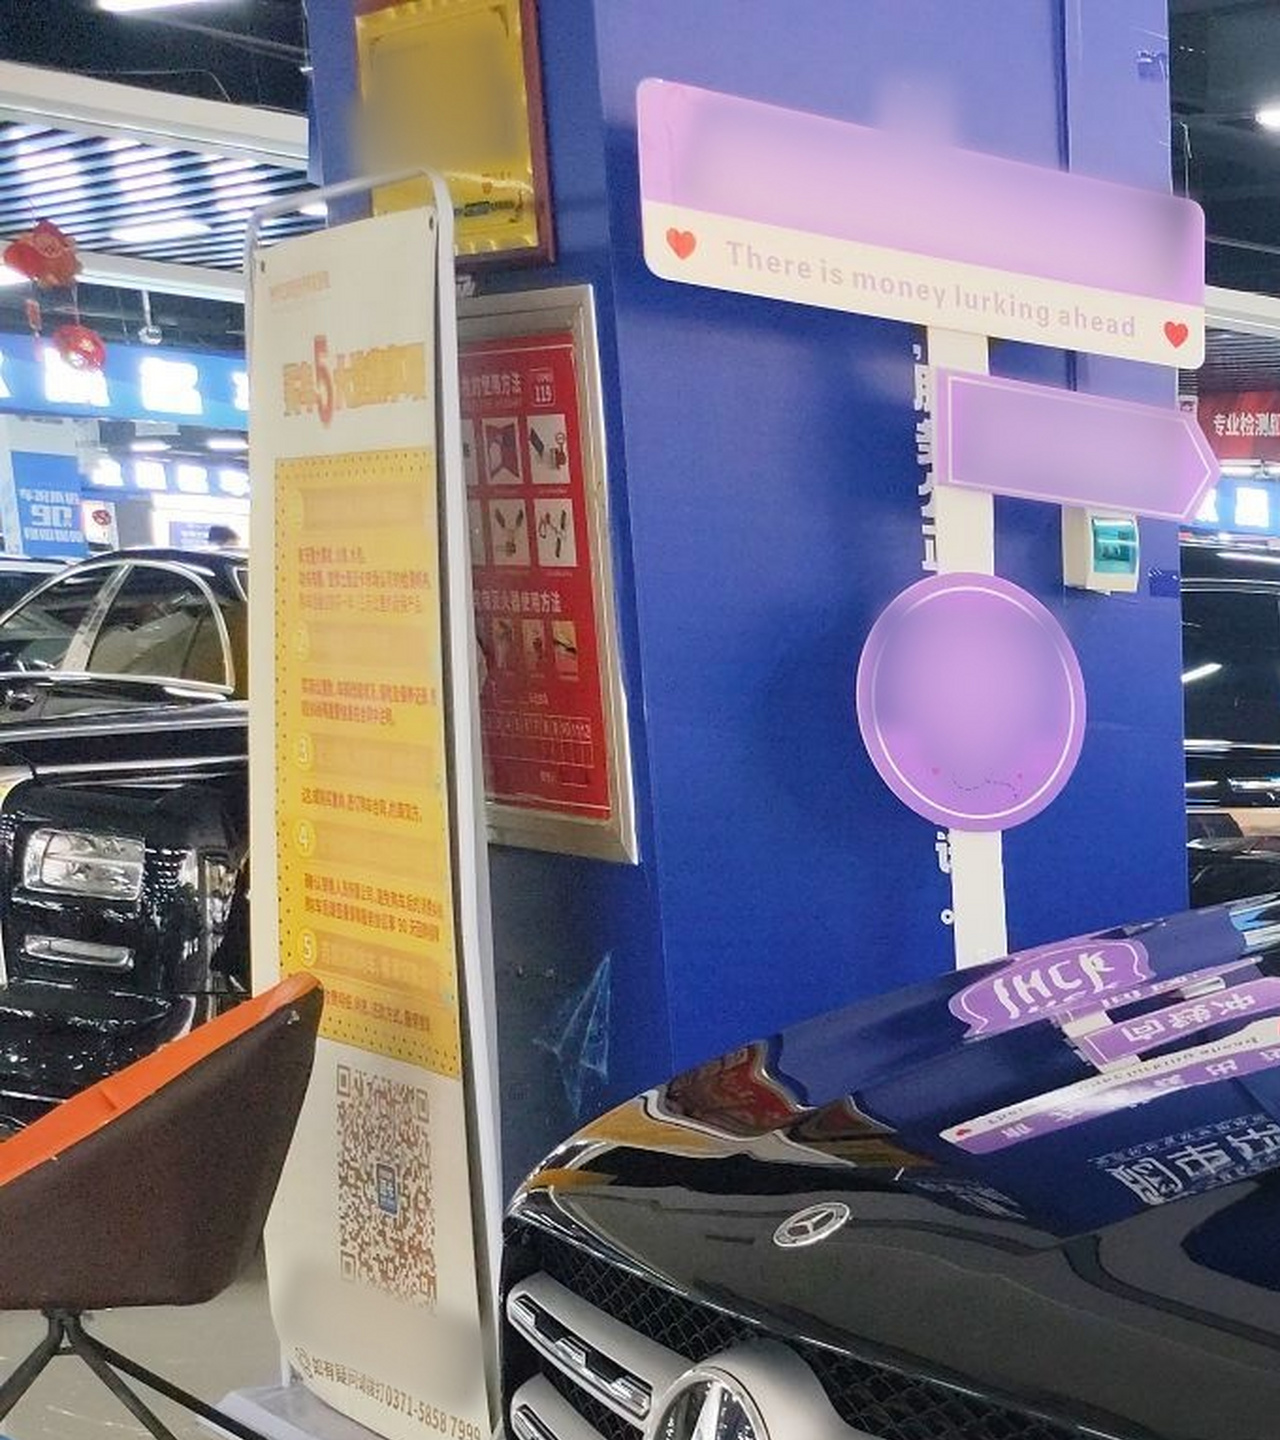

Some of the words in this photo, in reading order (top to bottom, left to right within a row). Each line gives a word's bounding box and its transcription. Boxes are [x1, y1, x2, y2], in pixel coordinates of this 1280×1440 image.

[726, 240, 812, 279] There
[819, 259, 843, 285] is
[853, 271, 945, 309] money
[954, 284, 1049, 327] lurking
[1060, 306, 1136, 338] ahead
